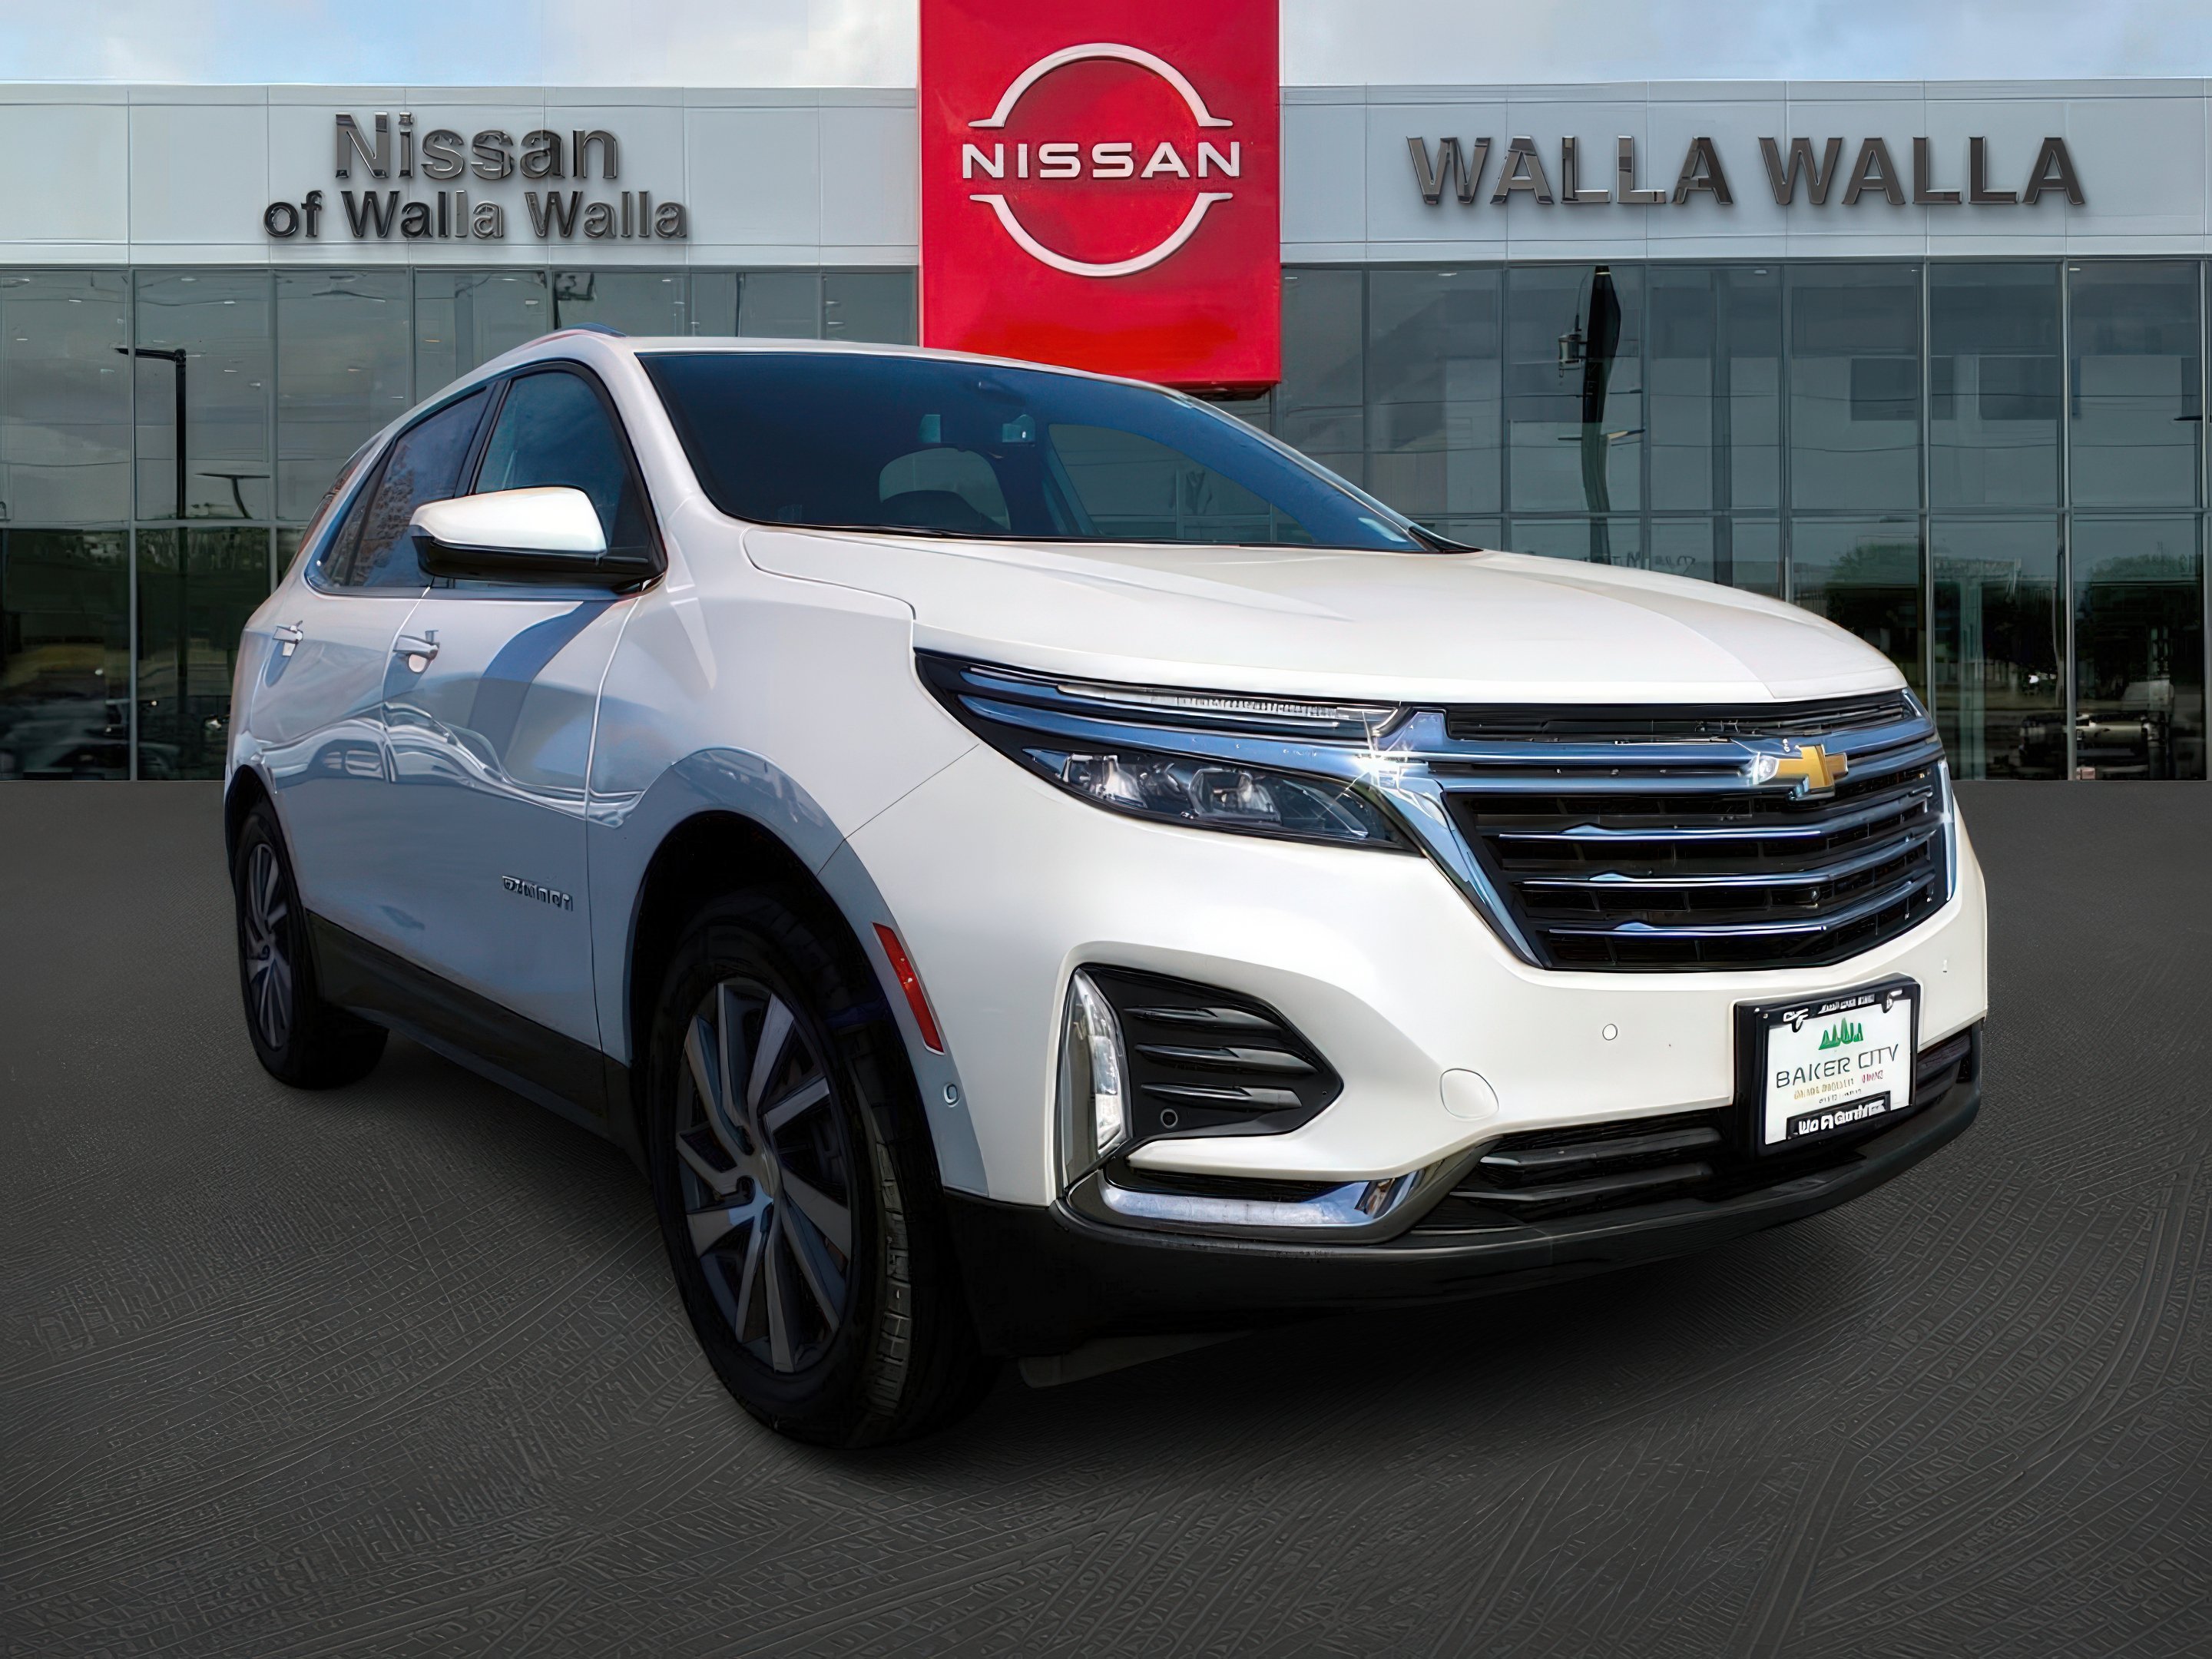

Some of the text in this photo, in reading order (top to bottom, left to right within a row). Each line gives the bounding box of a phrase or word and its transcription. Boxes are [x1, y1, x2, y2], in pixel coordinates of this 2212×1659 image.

[334, 111, 619, 180] Nissan
[962, 141, 1240, 179] NISSAN
[1406, 134, 2086, 206] WALLA WALLA
[263, 190, 687, 239] of Walla Walla
[1776, 1057, 1850, 1089] BAKER
[1858, 1043, 1899, 1069] CITY
